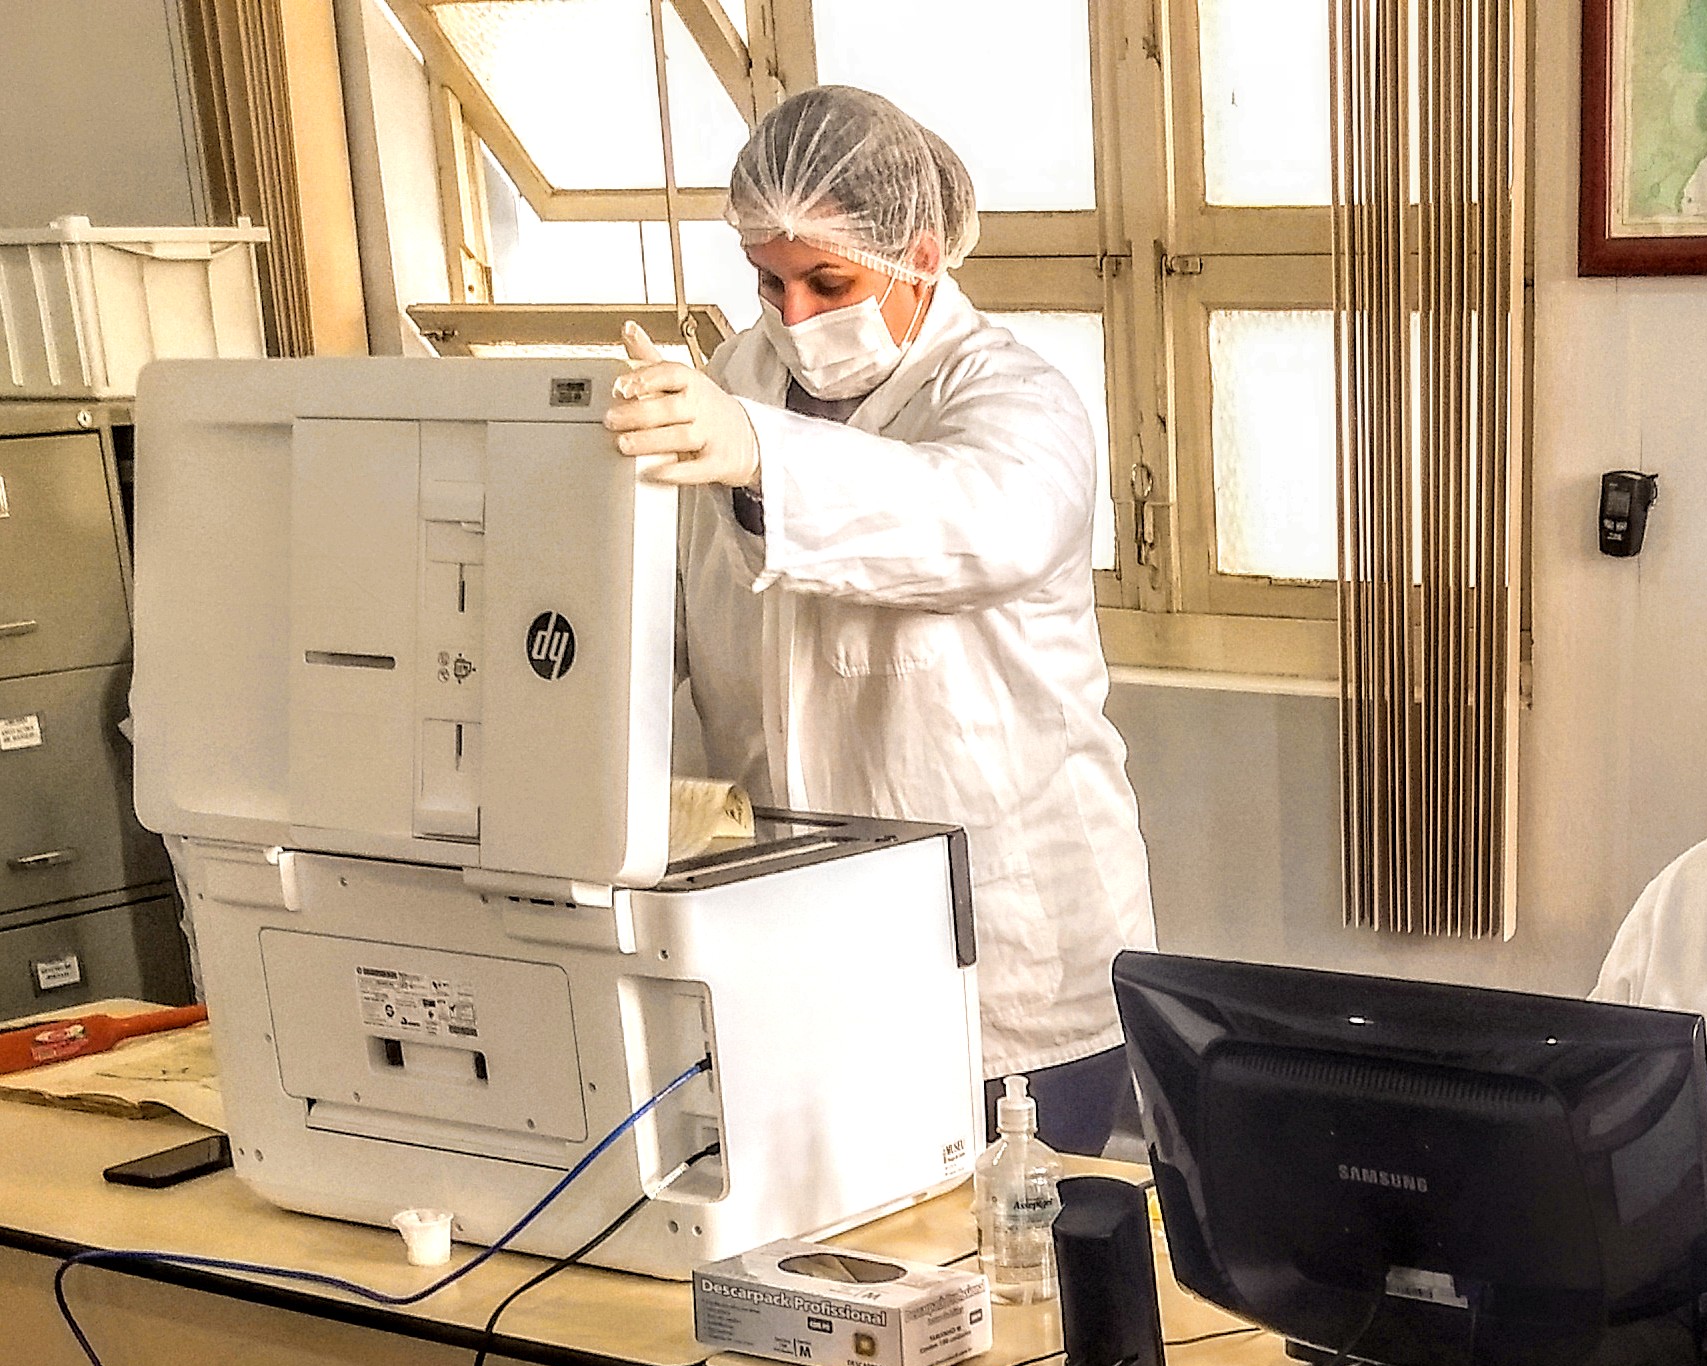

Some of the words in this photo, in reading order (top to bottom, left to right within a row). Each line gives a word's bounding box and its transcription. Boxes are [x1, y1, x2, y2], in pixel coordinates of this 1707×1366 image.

[1338, 1163, 1428, 1193] SAMSUNG
[701, 1278, 792, 1309] Descarpack
[794, 1295, 887, 1328] Profissional
[799, 1344, 813, 1359] M
